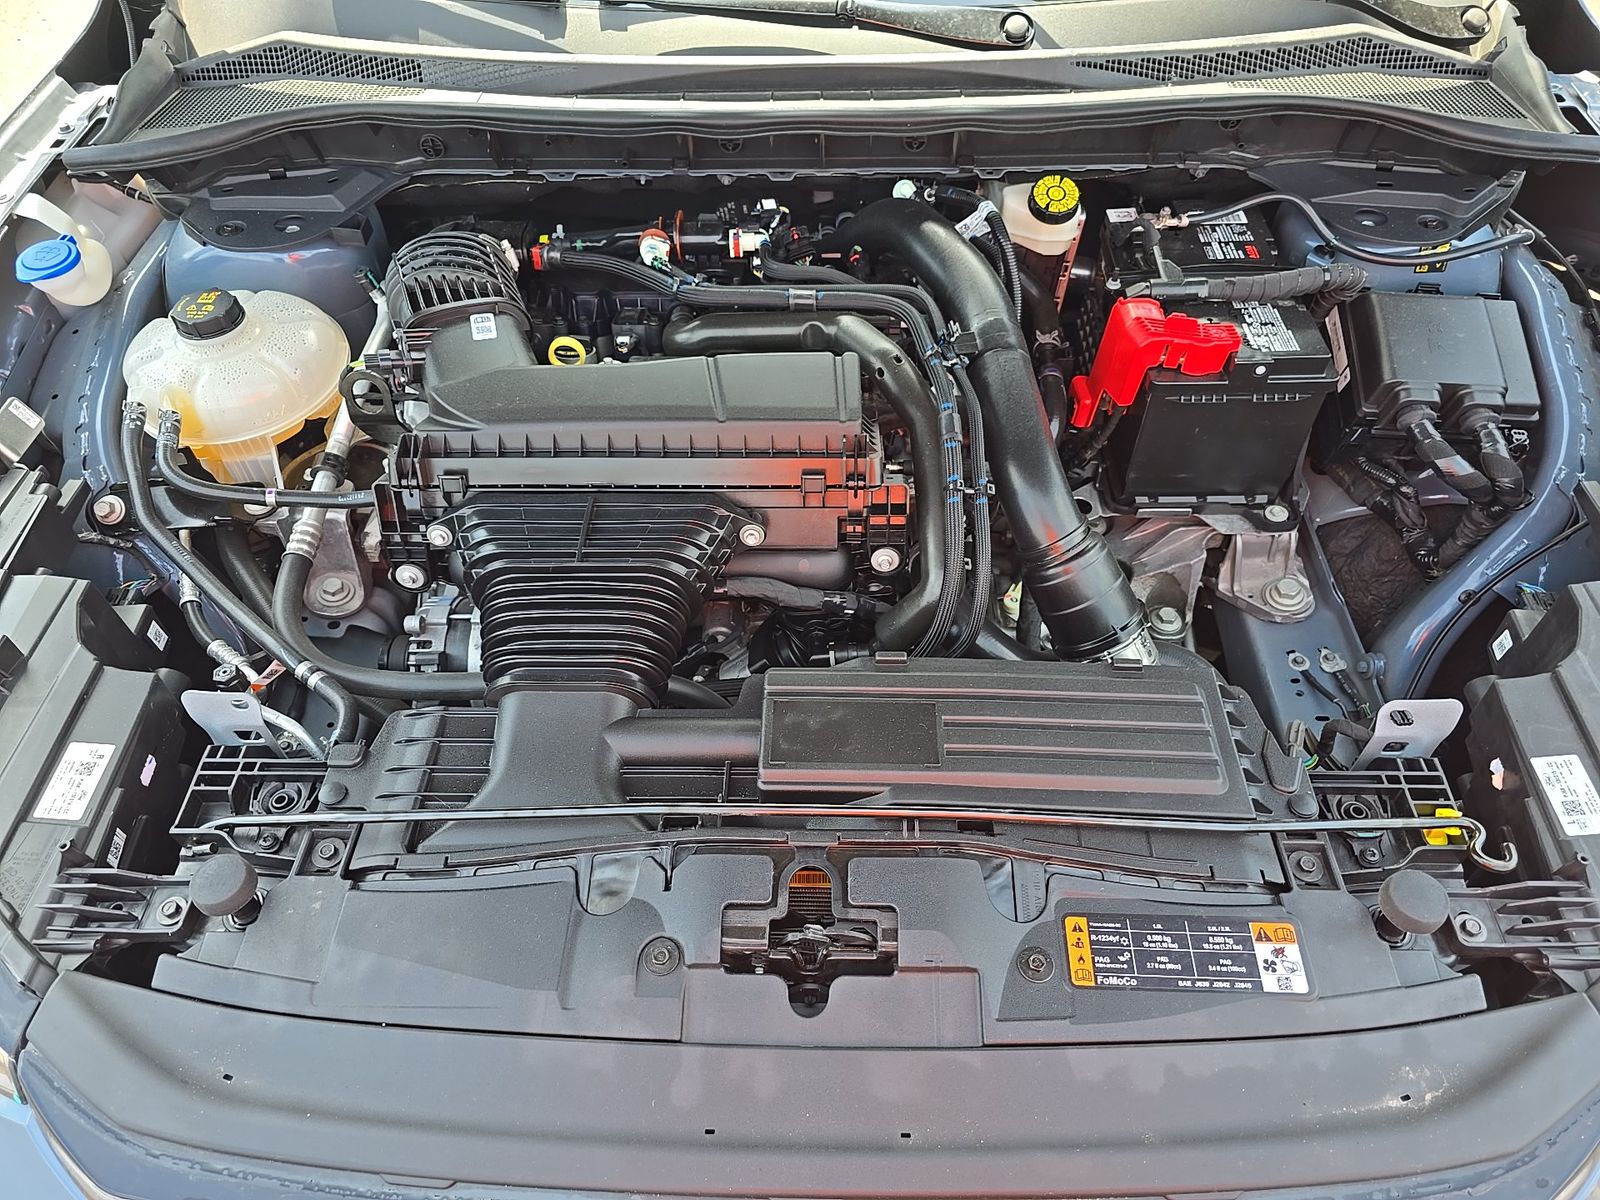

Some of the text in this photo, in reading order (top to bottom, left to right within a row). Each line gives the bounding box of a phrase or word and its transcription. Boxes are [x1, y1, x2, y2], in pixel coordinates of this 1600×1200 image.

[1090, 934, 1120, 943] R-1234yf
[1163, 935, 1171, 943] kg
[1225, 937, 1233, 945] kg
[1097, 975, 1138, 986] FoMoCo
